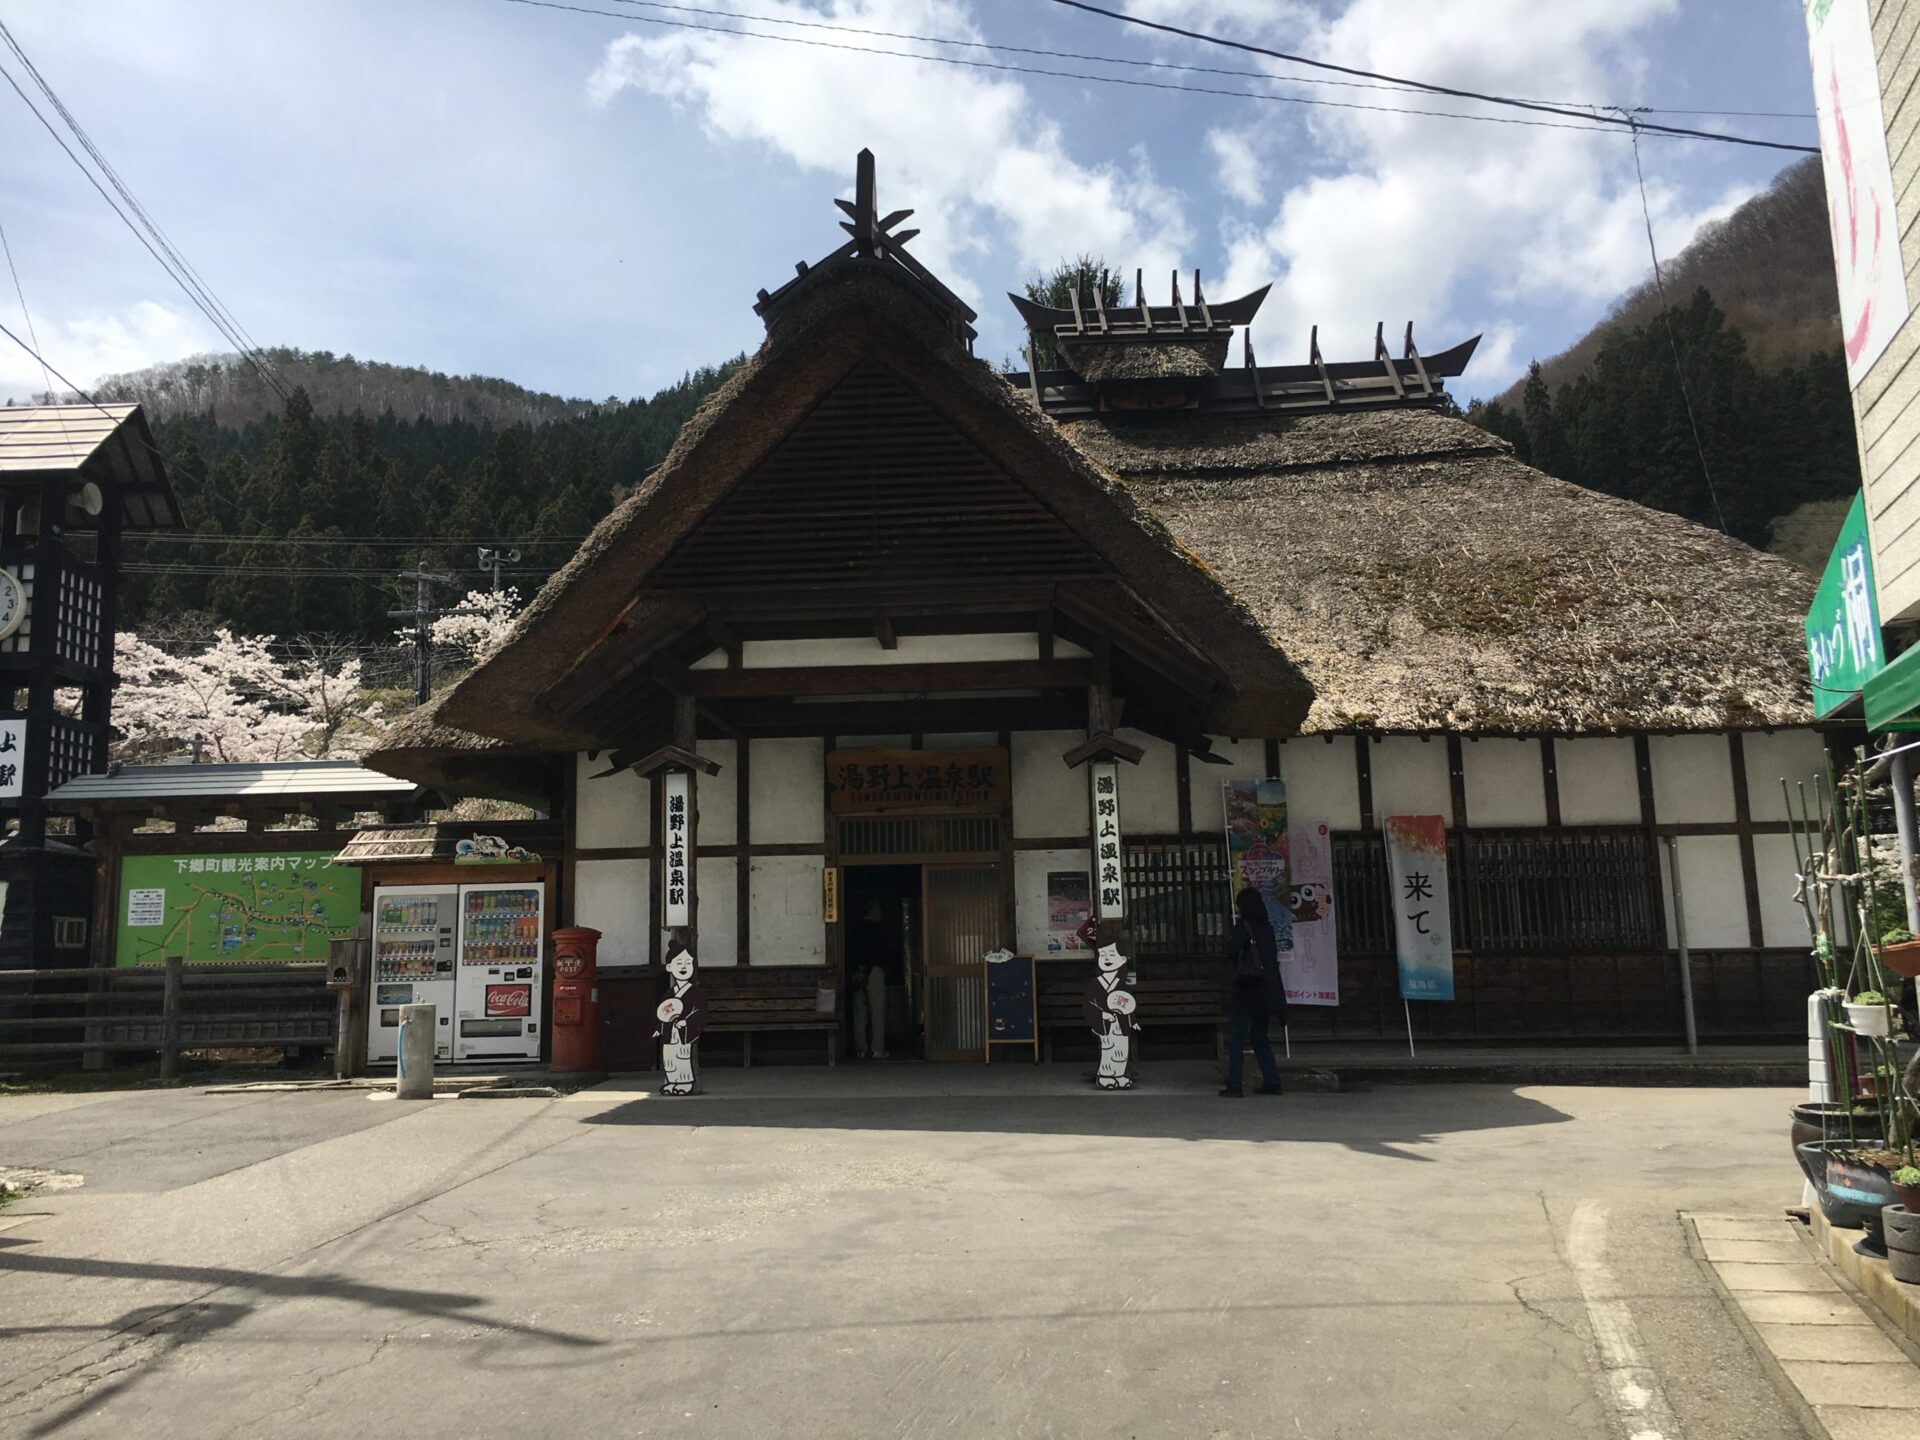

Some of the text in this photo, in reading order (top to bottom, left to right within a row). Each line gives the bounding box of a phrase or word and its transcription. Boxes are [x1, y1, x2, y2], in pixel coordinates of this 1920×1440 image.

[5, 586, 11, 596] 2
[7, 599, 14, 609] 3
[2, 611, 9, 622] 4
[838, 762, 995, 791] 湯野上温泉駅
[669, 795, 685, 905] 湯野上温泉駅
[1096, 776, 1121, 906] 湯野上温泉駅
[173, 855, 334, 873] 下郷町観光案内マップ
